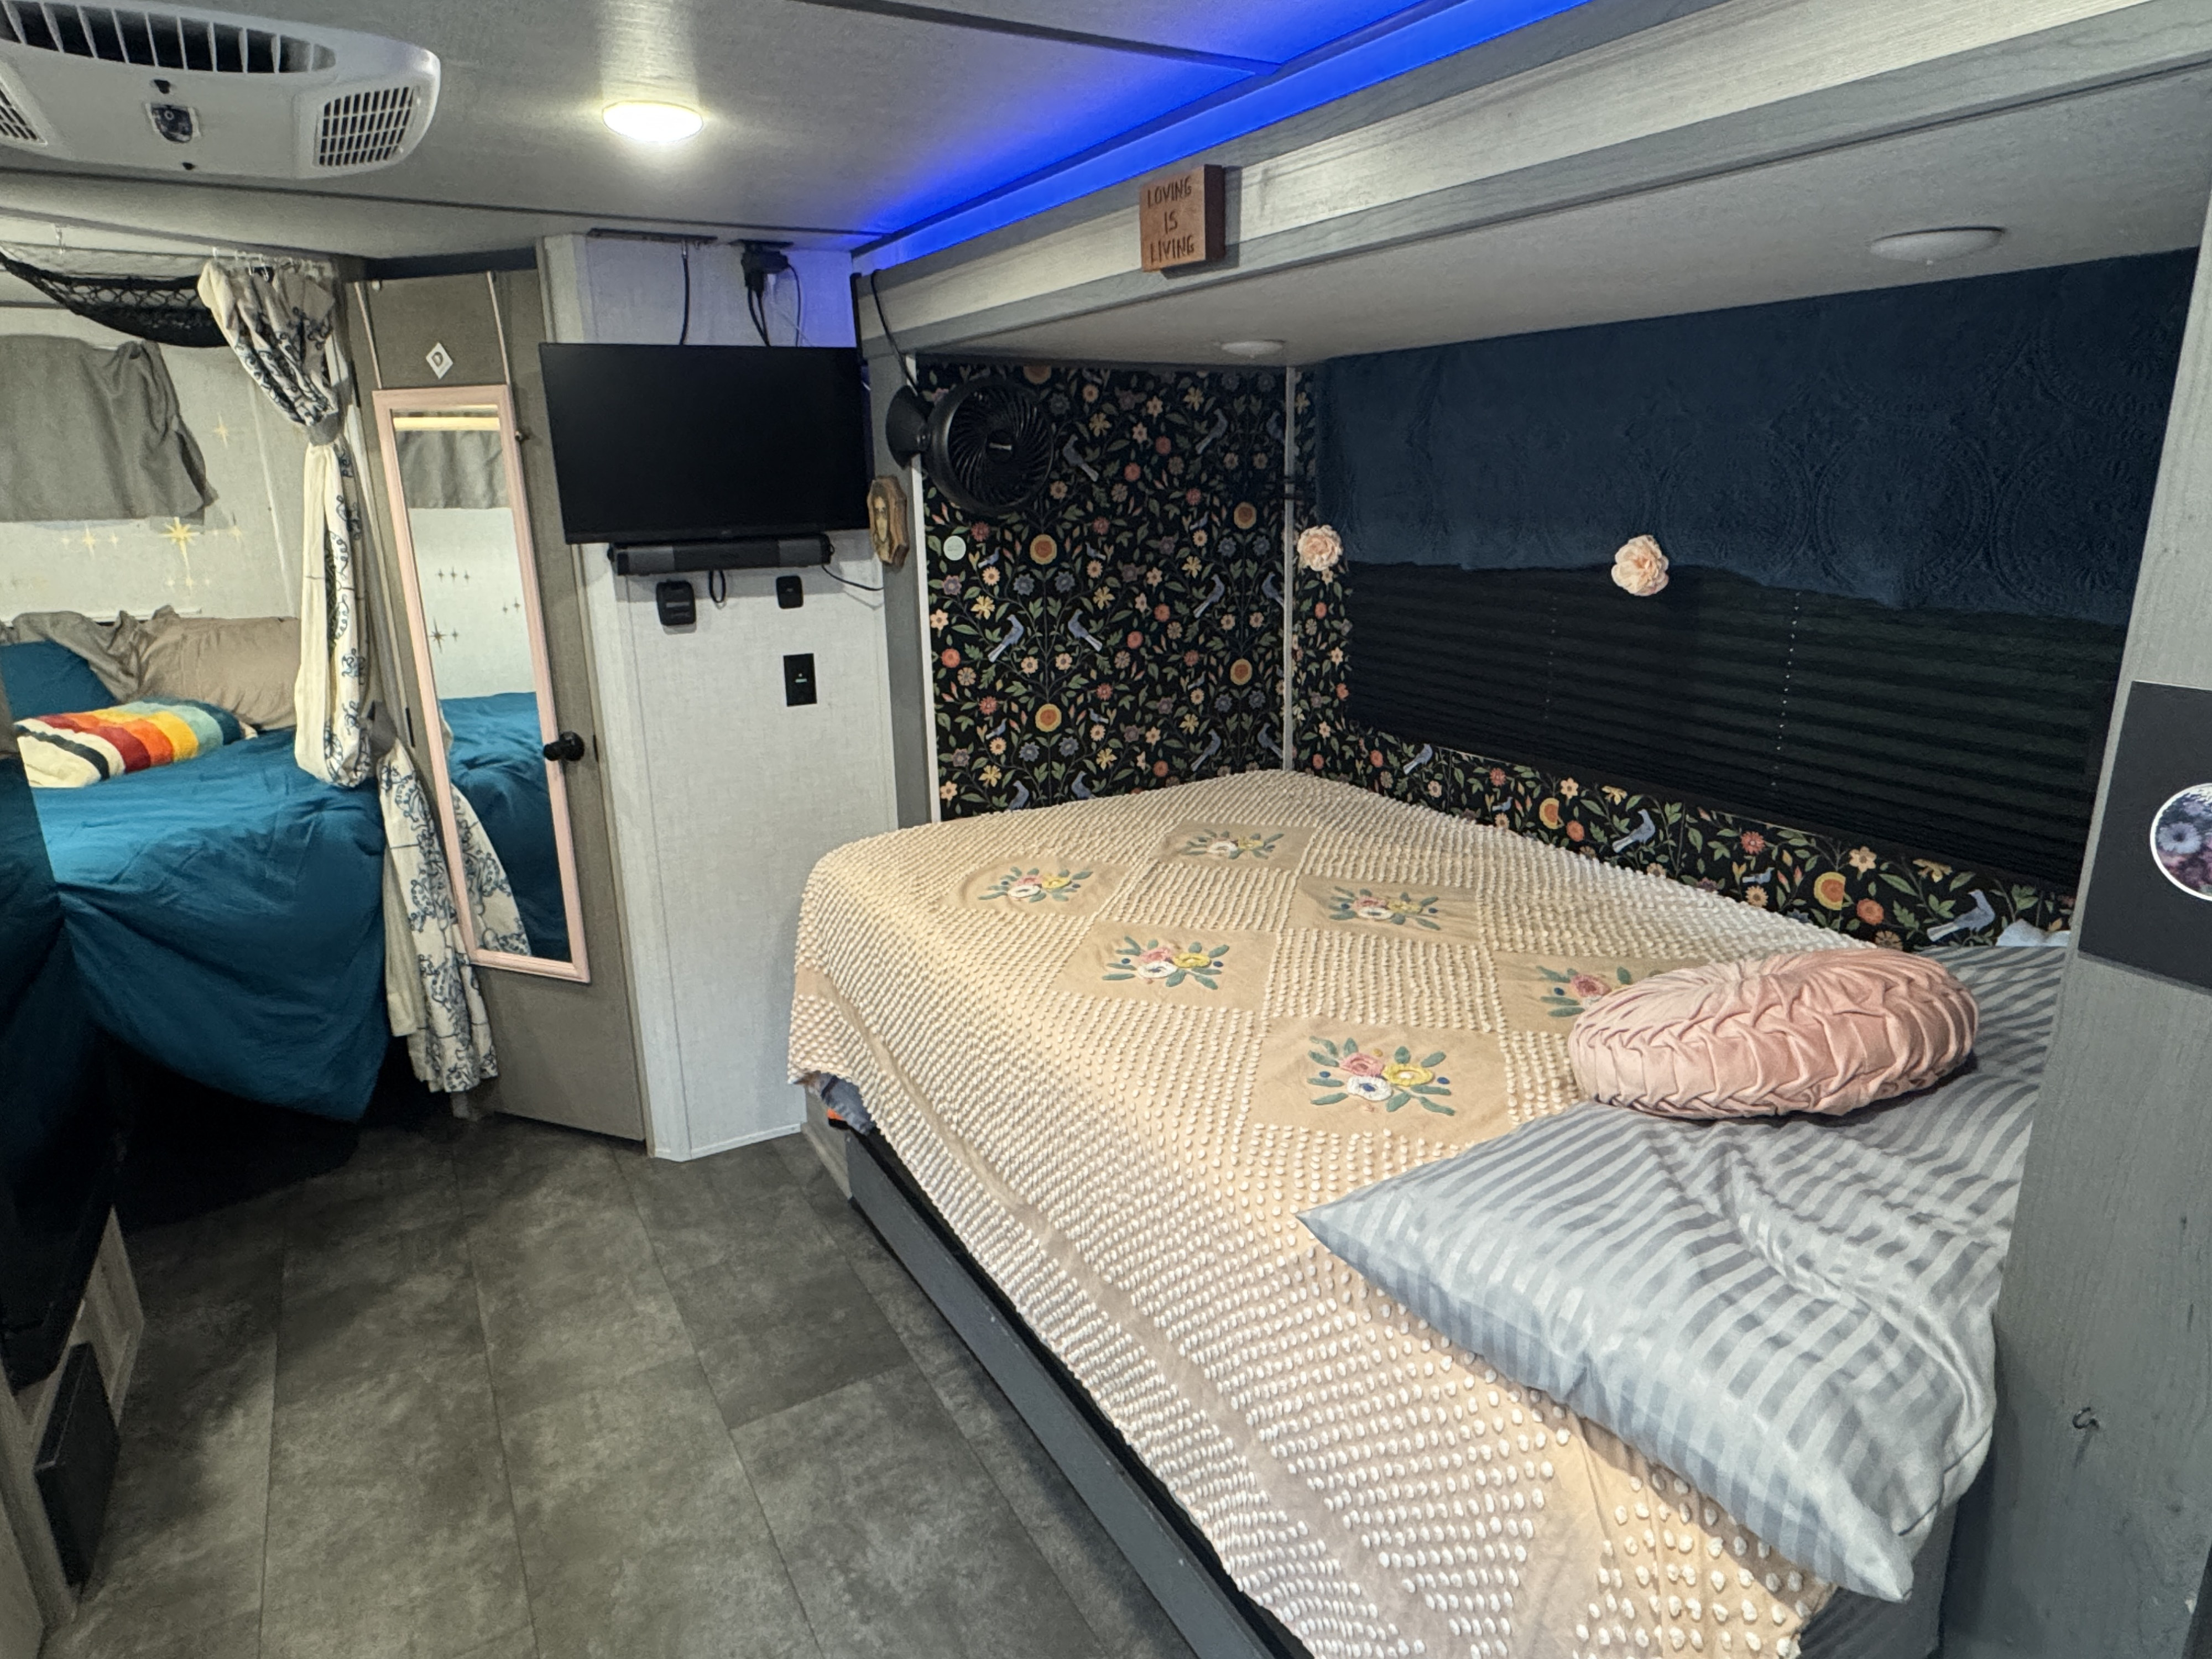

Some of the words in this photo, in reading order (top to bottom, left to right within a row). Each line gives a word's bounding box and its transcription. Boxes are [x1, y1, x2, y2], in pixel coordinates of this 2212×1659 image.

[1147, 175, 1192, 208] LOVING
[1164, 210, 1178, 235] IS
[1150, 235, 1195, 265] LIVING
